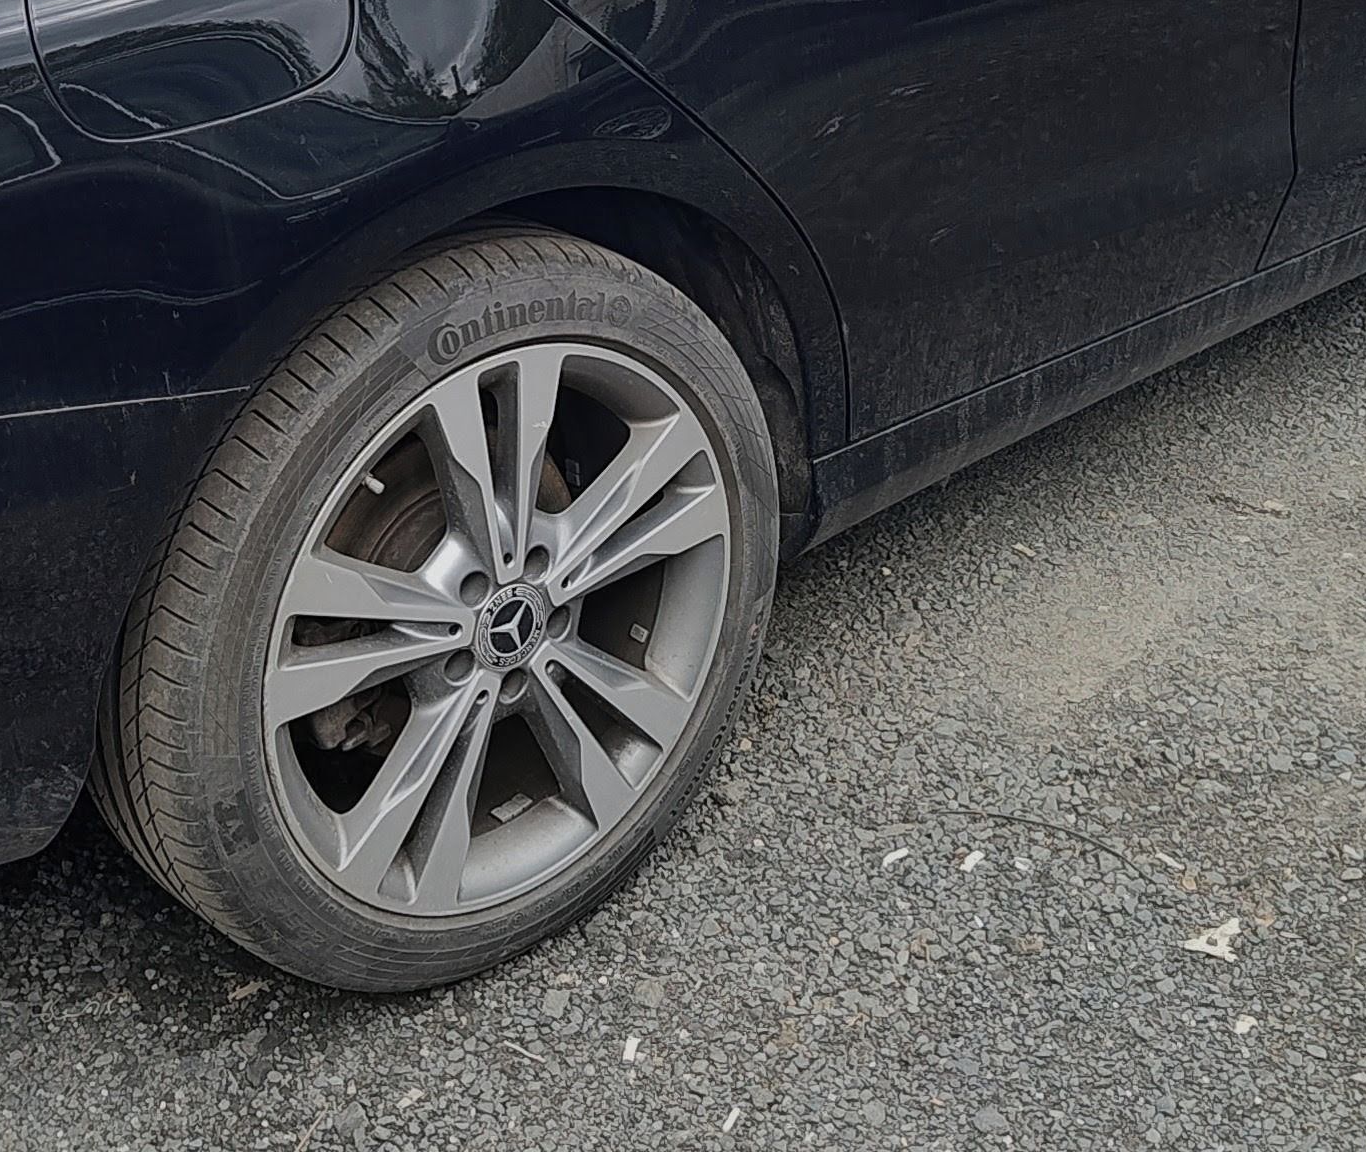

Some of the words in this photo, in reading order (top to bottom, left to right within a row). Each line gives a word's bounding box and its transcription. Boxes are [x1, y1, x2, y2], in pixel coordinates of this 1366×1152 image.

[427, 289, 605, 366] Continental
[489, 589, 514, 612] BENZ
[498, 629, 541, 666] MERCEDES
